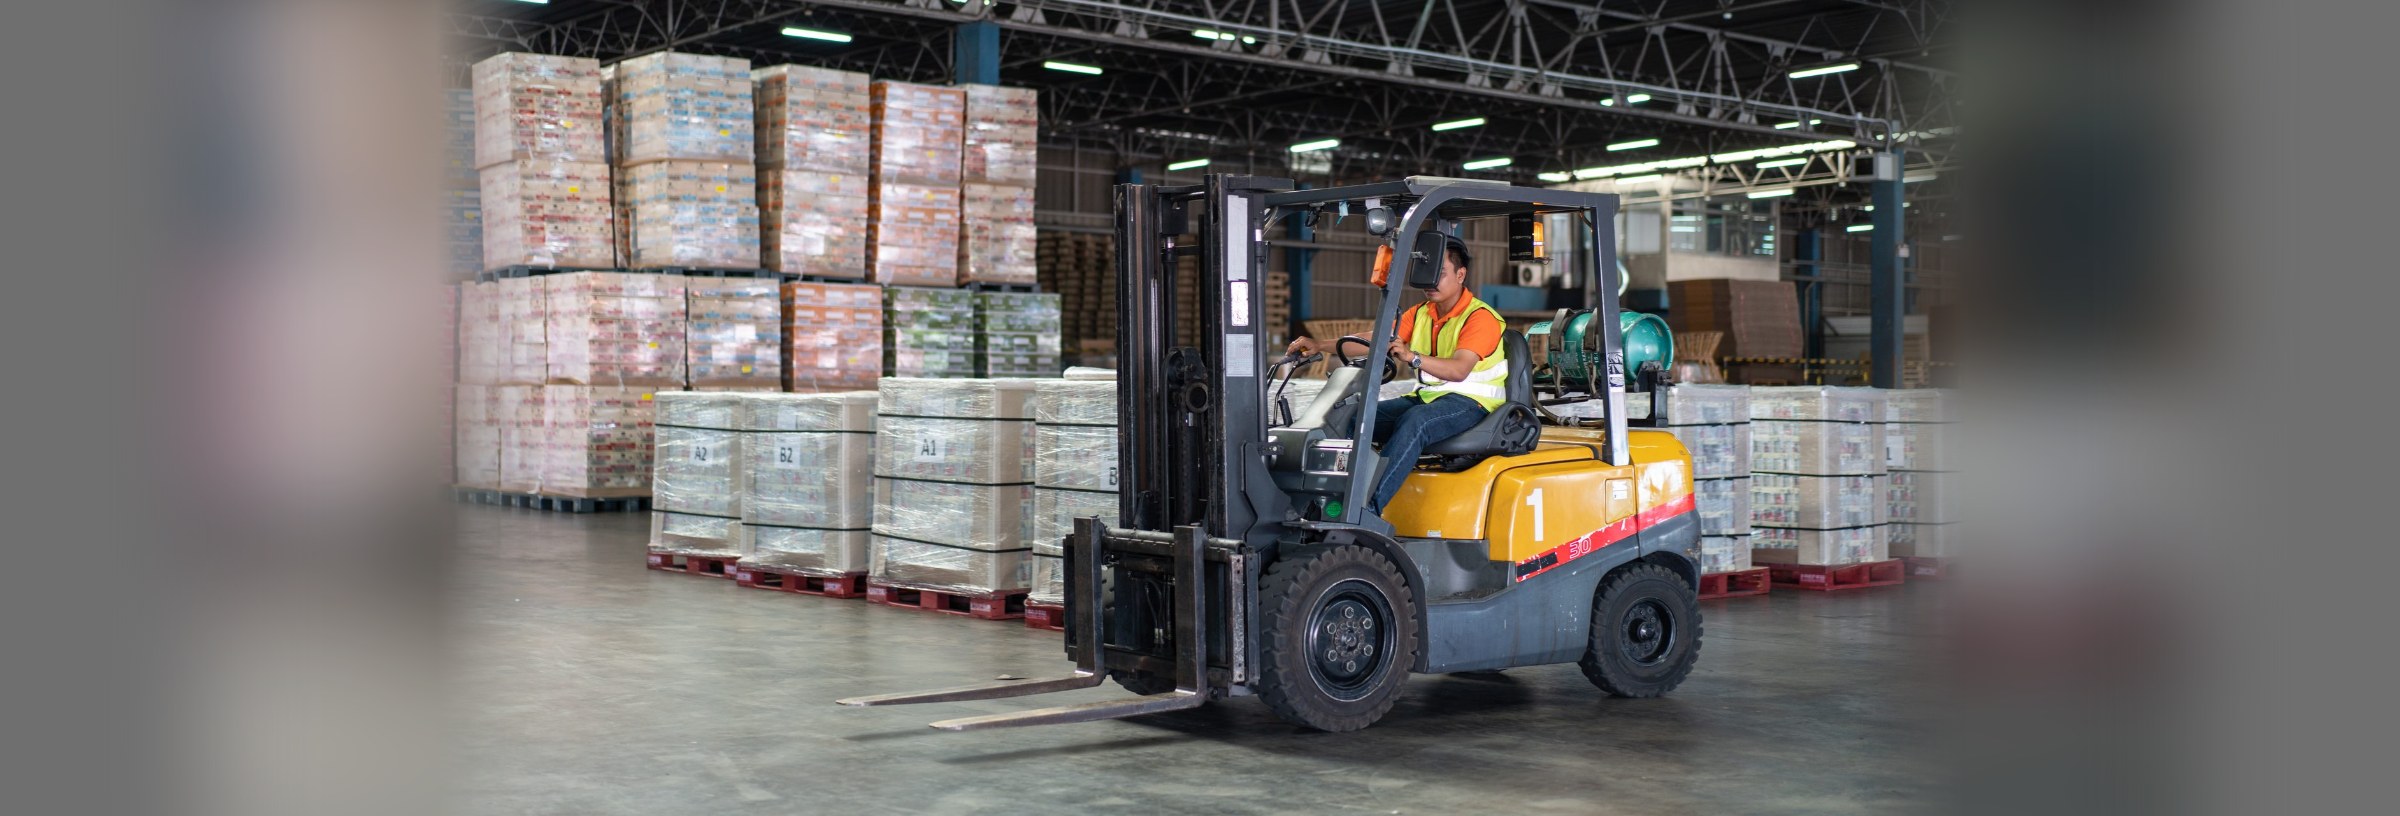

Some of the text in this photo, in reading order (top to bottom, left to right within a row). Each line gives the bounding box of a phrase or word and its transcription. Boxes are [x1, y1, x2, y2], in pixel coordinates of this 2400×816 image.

[694, 446, 706, 461] A2
[780, 447, 793, 463] B2
[921, 439, 936, 456] A1
[1109, 466, 1117, 485] B
[1526, 487, 1544, 542] 1
[1569, 536, 1592, 560] 30
